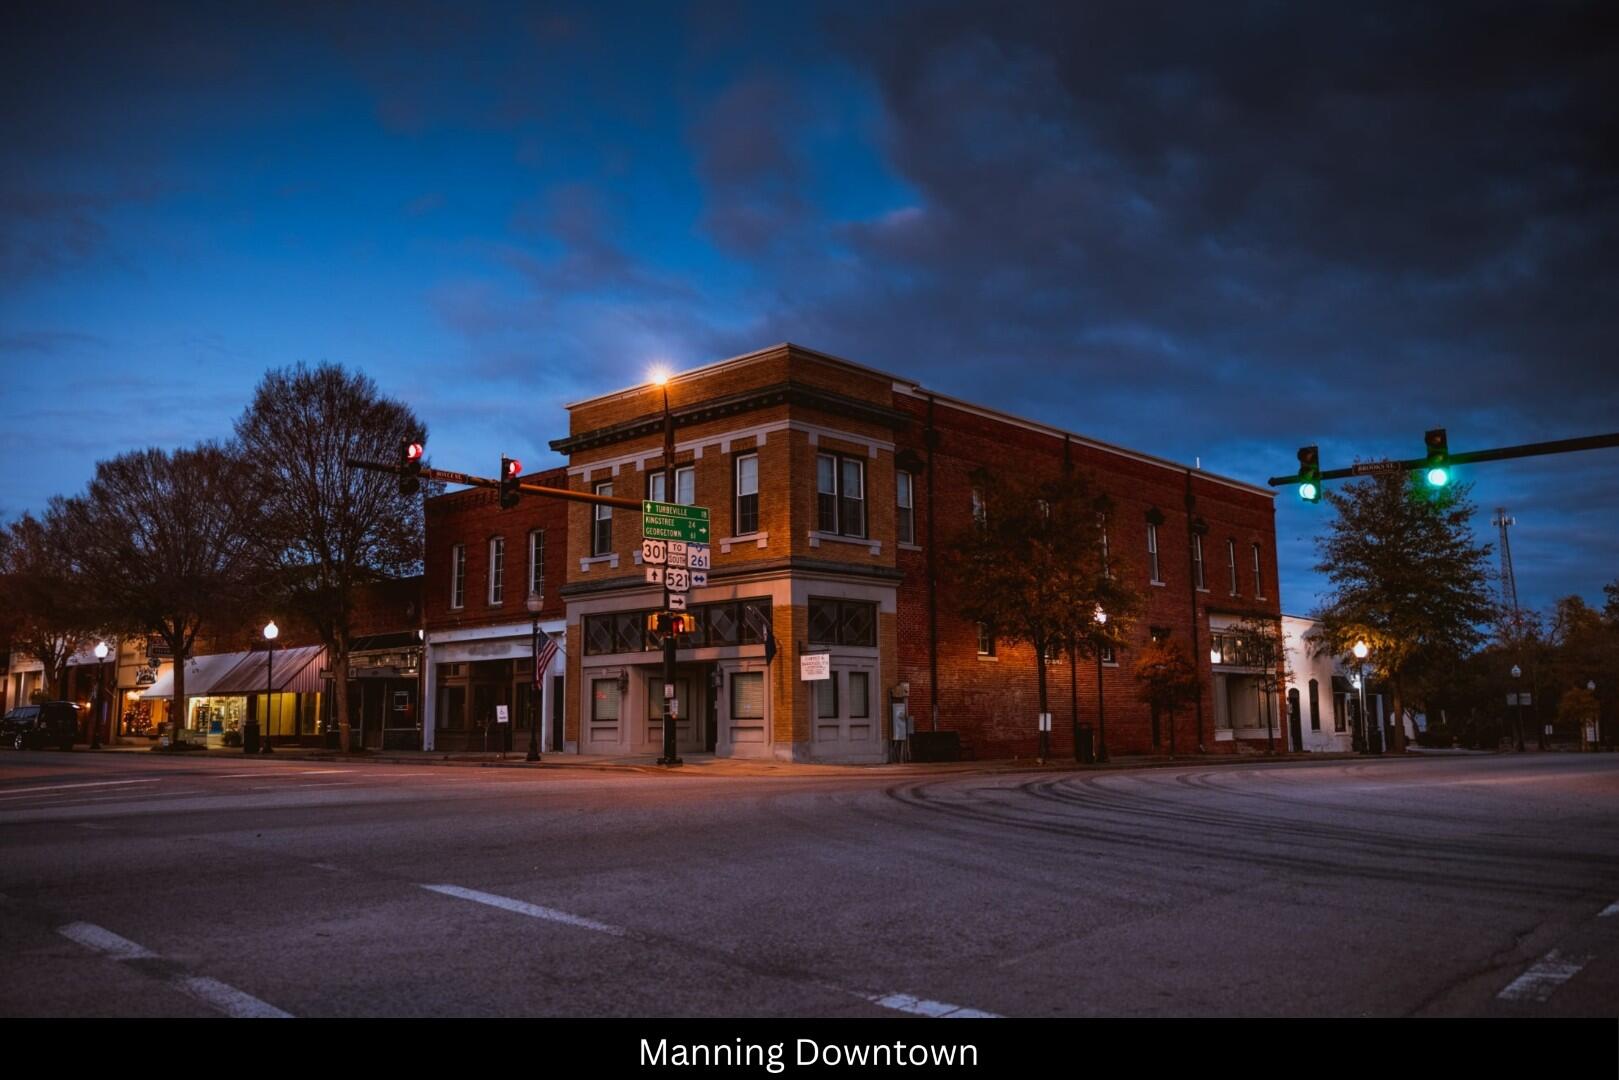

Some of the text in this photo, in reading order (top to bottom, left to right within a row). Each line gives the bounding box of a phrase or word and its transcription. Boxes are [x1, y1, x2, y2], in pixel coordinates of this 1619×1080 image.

[655, 504, 688, 516] TURBEVILLE
[645, 516, 675, 526] KINGSTREE
[645, 527, 682, 537] GEORGETOWN
[644, 544, 665, 560] 301
[691, 554, 708, 567] 261
[668, 573, 688, 588] 521
